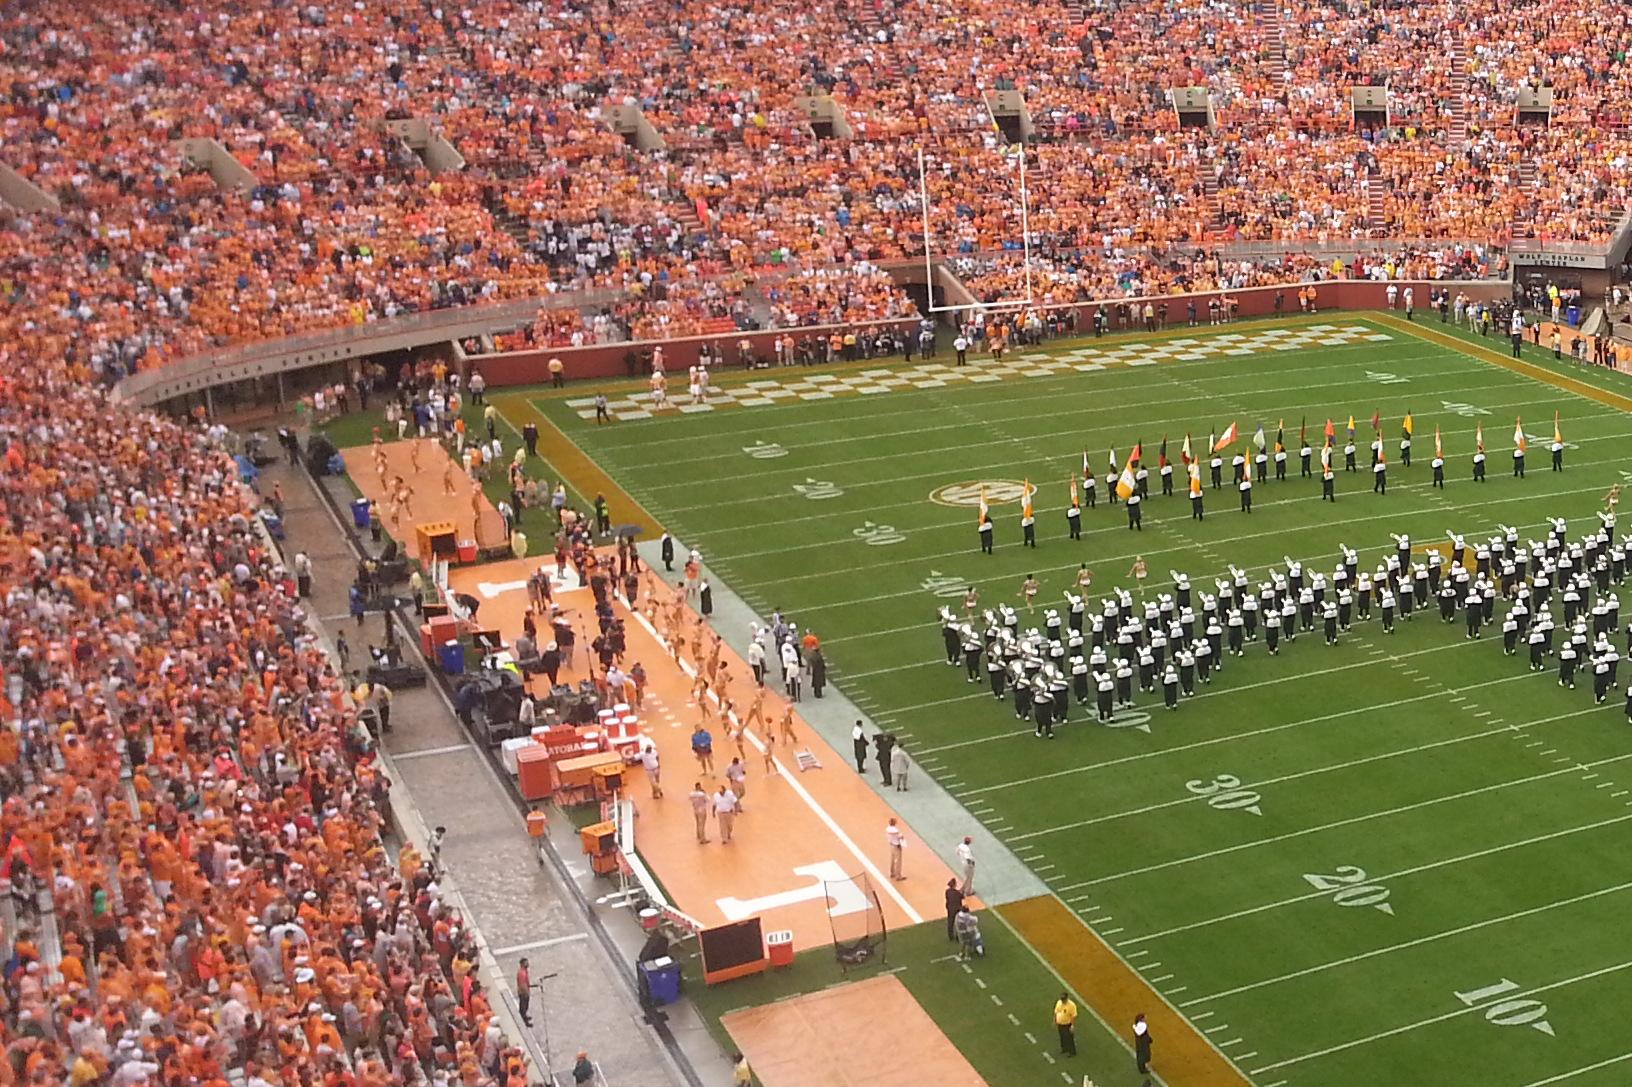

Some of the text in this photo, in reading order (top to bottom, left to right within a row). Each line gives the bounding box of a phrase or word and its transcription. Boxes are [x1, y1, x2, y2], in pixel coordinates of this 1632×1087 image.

[792, 480, 845, 499] 20
[852, 524, 907, 546] 30
[1185, 773, 1262, 810] 30
[1302, 864, 1391, 907] 20
[1453, 977, 1548, 1026] 10
